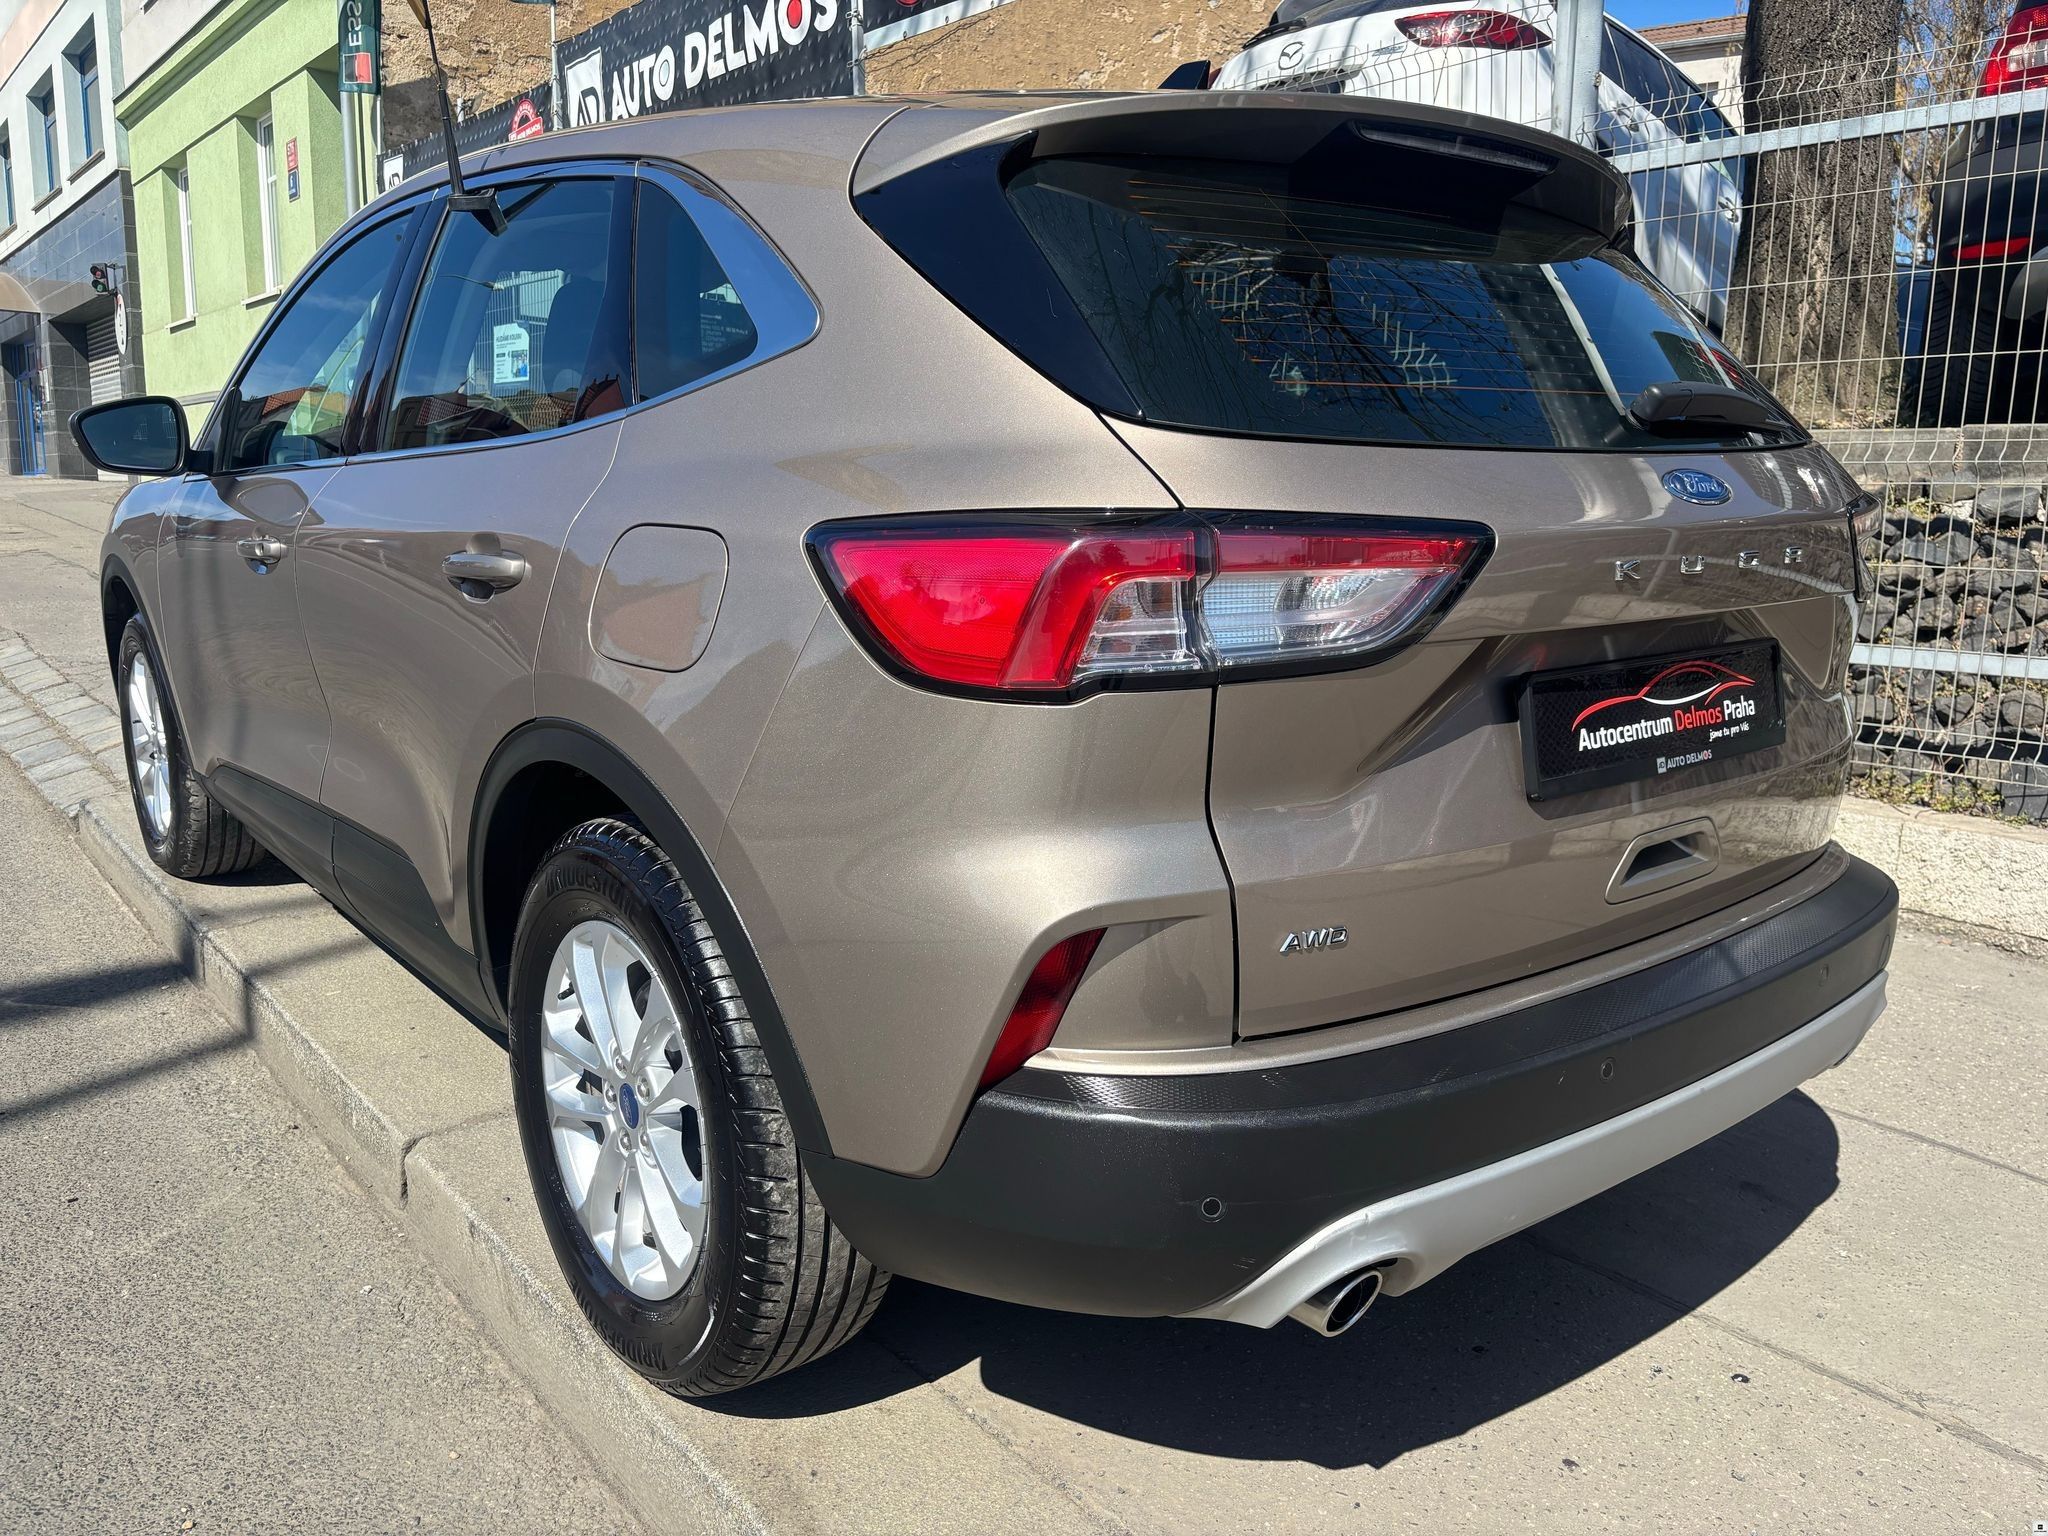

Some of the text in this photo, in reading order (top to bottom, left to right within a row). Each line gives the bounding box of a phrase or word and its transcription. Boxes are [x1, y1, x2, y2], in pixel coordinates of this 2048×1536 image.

[611, 45, 675, 121] AUTO
[684, 0, 838, 90] DELMOS
[1682, 472, 1722, 494] Ford
[1578, 695, 1756, 752] Autocentrum Delmos Praha
[1730, 725, 1740, 738] pro
[1666, 755, 1686, 769] AUTO
[1686, 749, 1713, 765] DELMOS
[1279, 925, 1348, 953] AWD
